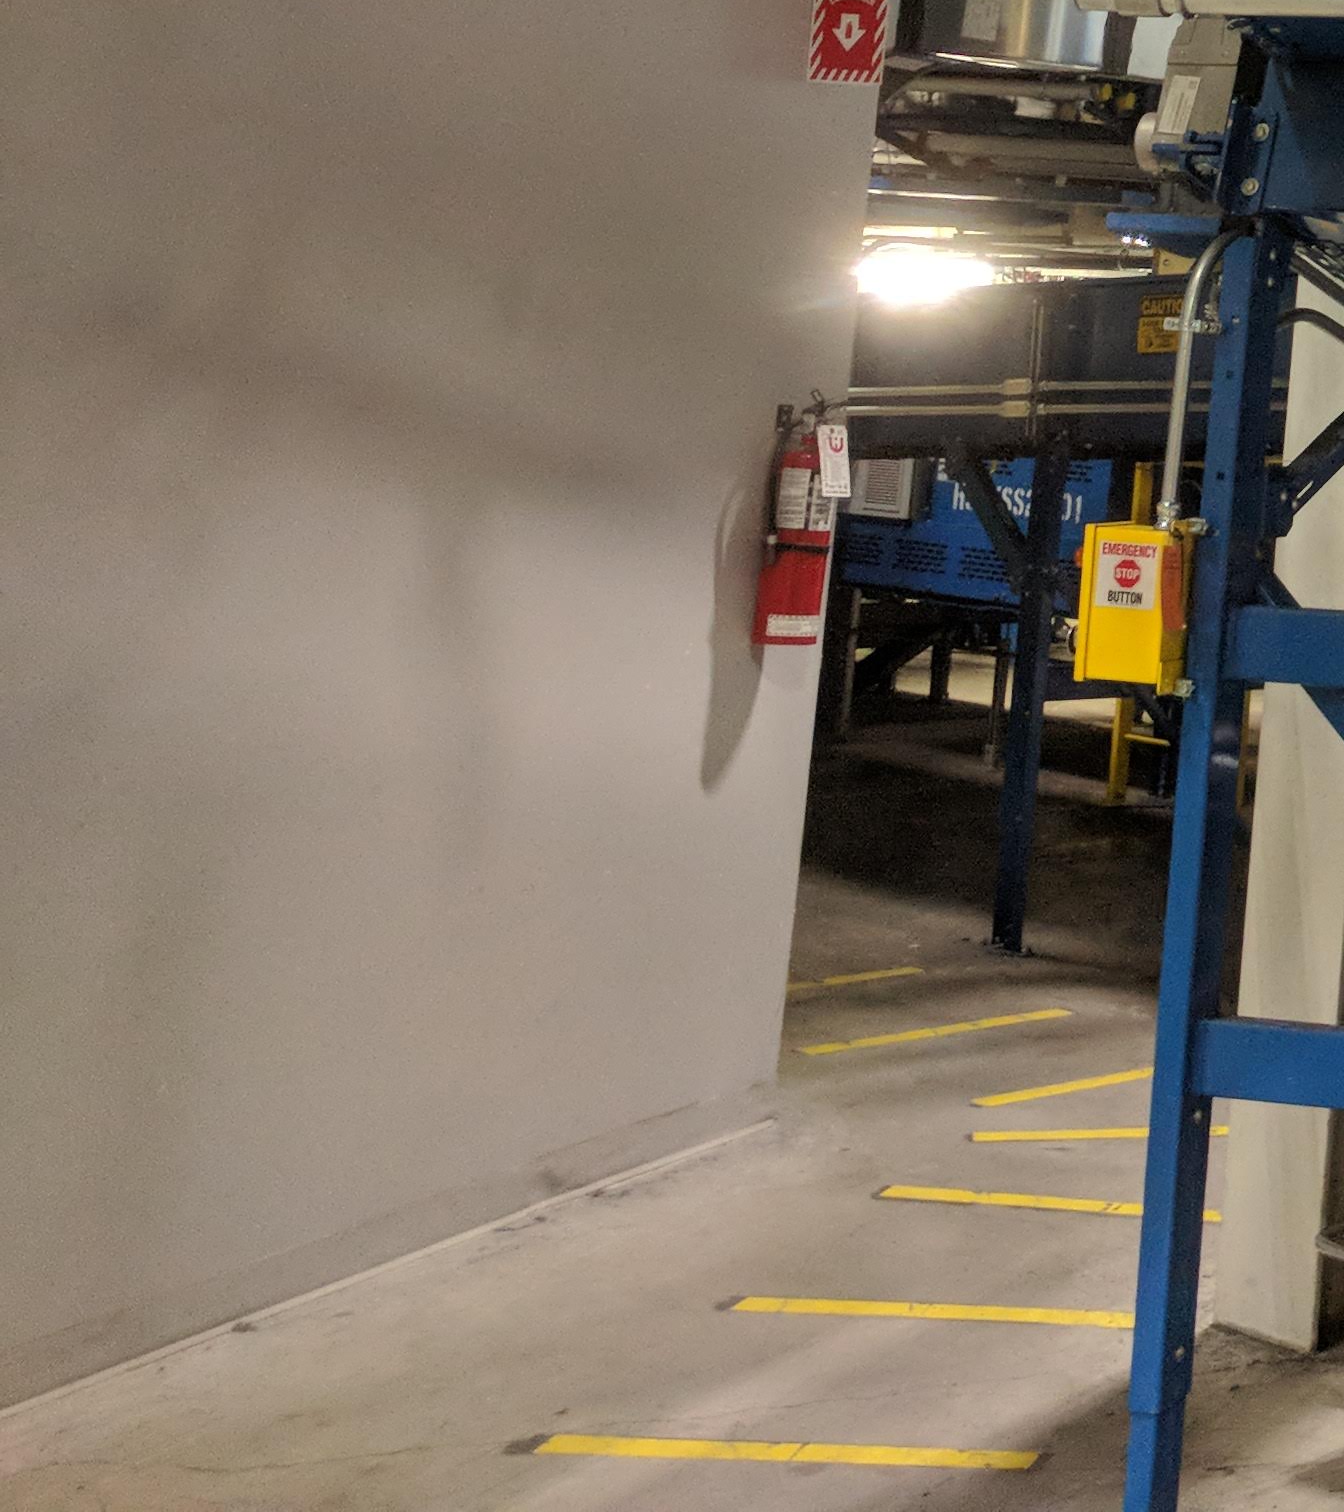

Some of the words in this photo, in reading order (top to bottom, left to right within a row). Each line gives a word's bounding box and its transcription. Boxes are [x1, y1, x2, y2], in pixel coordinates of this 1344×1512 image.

[1102, 542, 1158, 558] EMERGENCY
[1115, 568, 1139, 580] STOP
[1107, 590, 1143, 604] BUTTON
